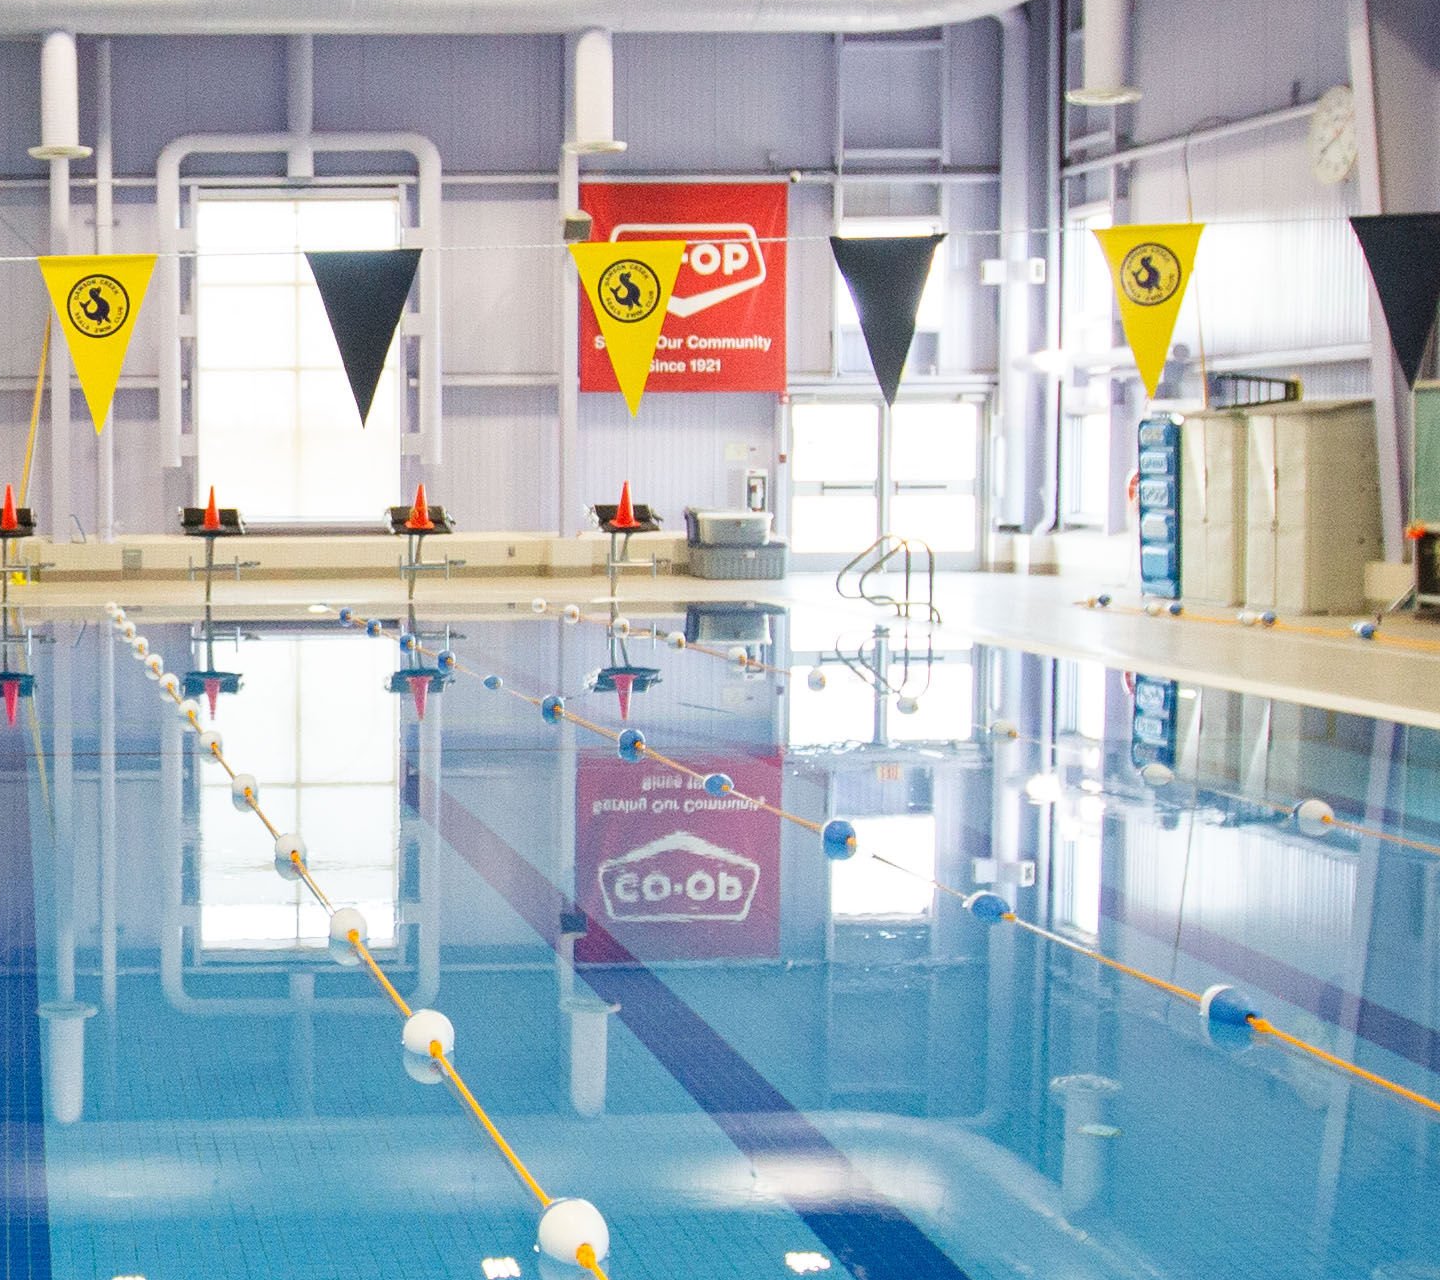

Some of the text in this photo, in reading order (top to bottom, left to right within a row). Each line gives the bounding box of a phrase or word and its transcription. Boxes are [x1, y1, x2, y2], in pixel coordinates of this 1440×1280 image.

[681, 243, 749, 275] -OP
[656, 335, 771, 352] Our Community
[649, 358, 721, 372] Since 1921
